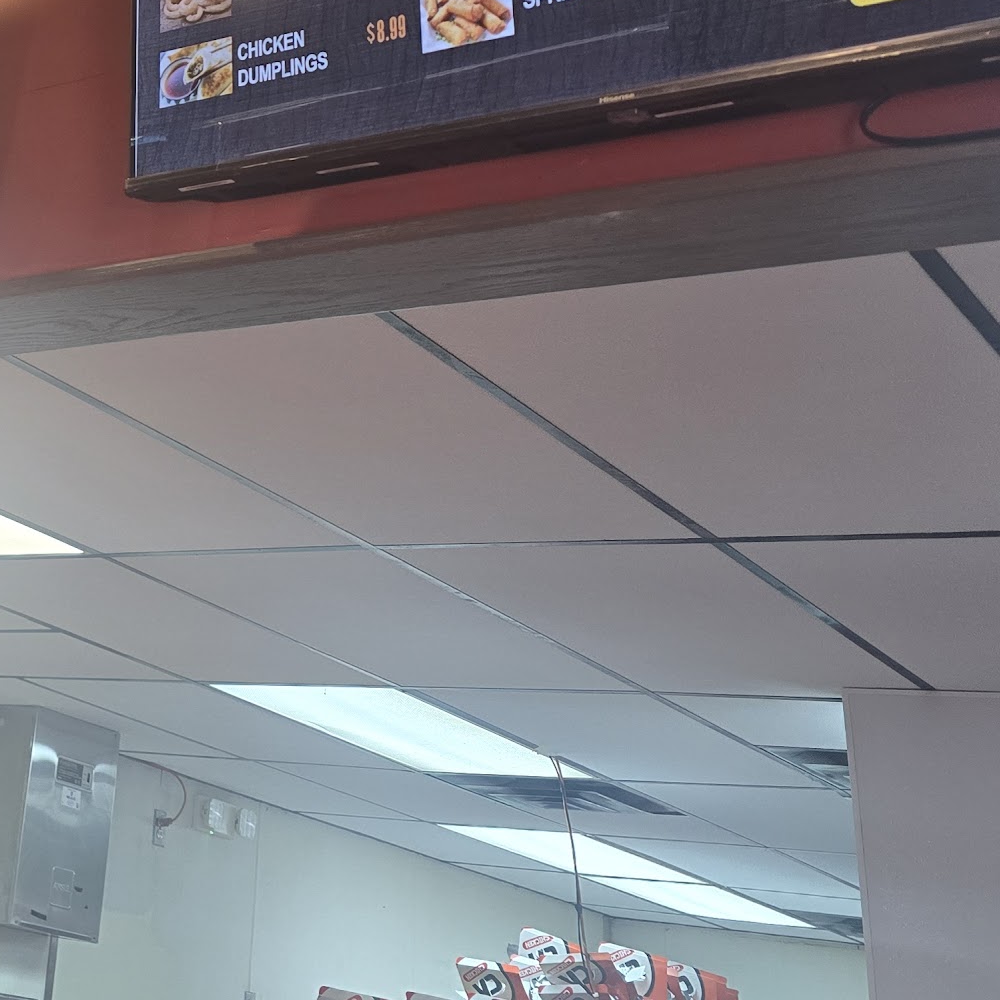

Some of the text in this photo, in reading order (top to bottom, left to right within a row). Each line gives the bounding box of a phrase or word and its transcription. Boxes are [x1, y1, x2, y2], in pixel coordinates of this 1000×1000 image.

[366, 14, 407, 44] $8.99
[237, 30, 305, 61] CHICKEN
[237, 51, 329, 87] DUMPLINGS
